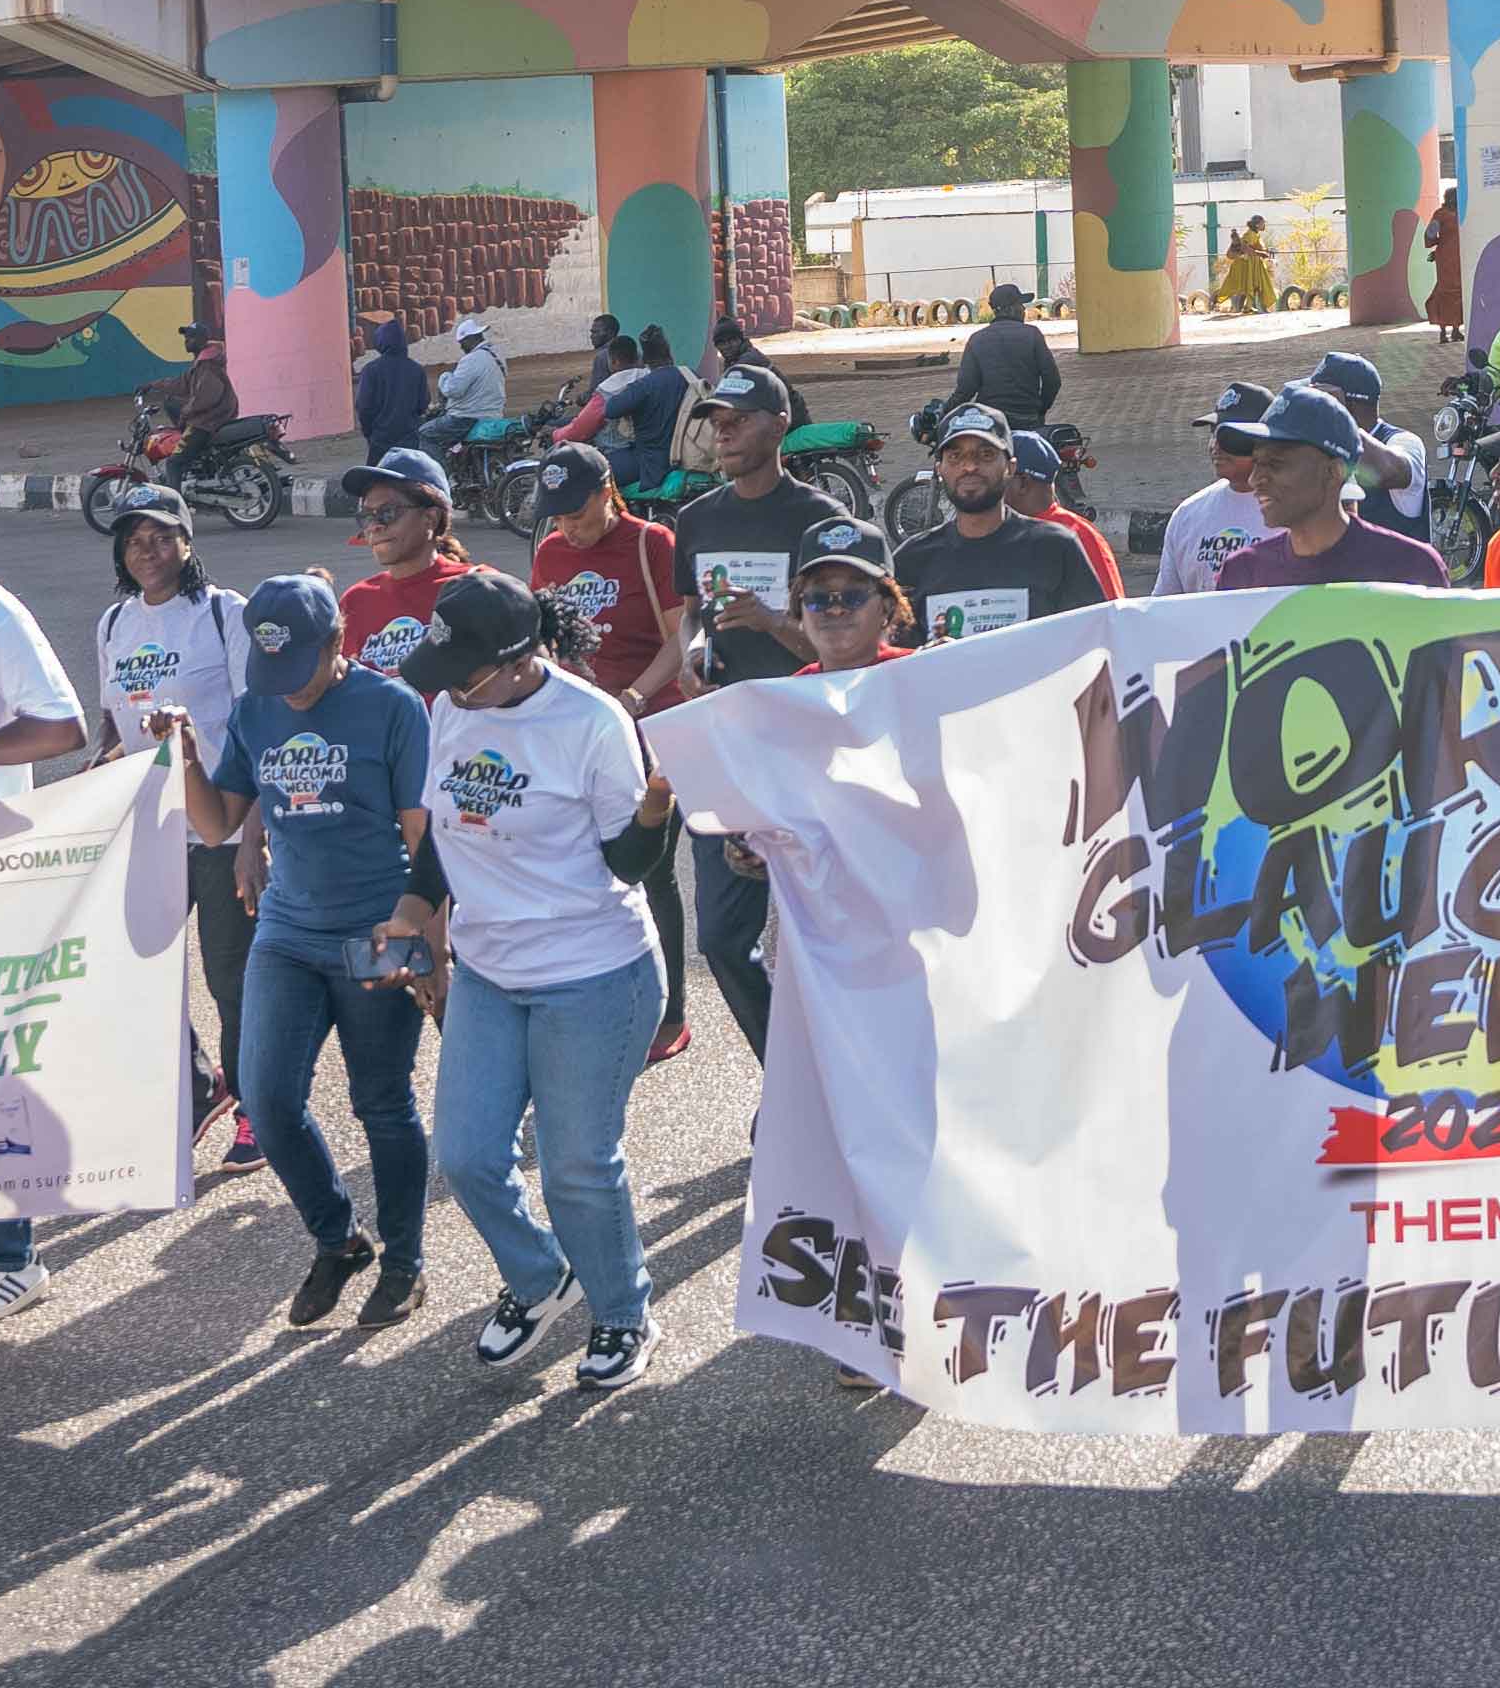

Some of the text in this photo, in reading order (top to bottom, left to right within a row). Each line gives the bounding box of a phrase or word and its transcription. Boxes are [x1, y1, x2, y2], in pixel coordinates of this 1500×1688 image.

[364, 626, 431, 650] WORL
[115, 651, 179, 673] WORLD
[110, 667, 177, 685] GLAUCOMA
[125, 679, 156, 692] WEEK
[261, 745, 348, 767] WORLD
[260, 765, 347, 783] GLAUCOMA
[449, 758, 531, 791] WORLD
[284, 781, 321, 794] WEEK
[439, 777, 523, 809] GLAUCOMA
[455, 798, 497, 817] WEEK
[35, 1173, 72, 1189] sure
[758, 1207, 904, 1352] SEE
[934, 1281, 1181, 1399] THE
